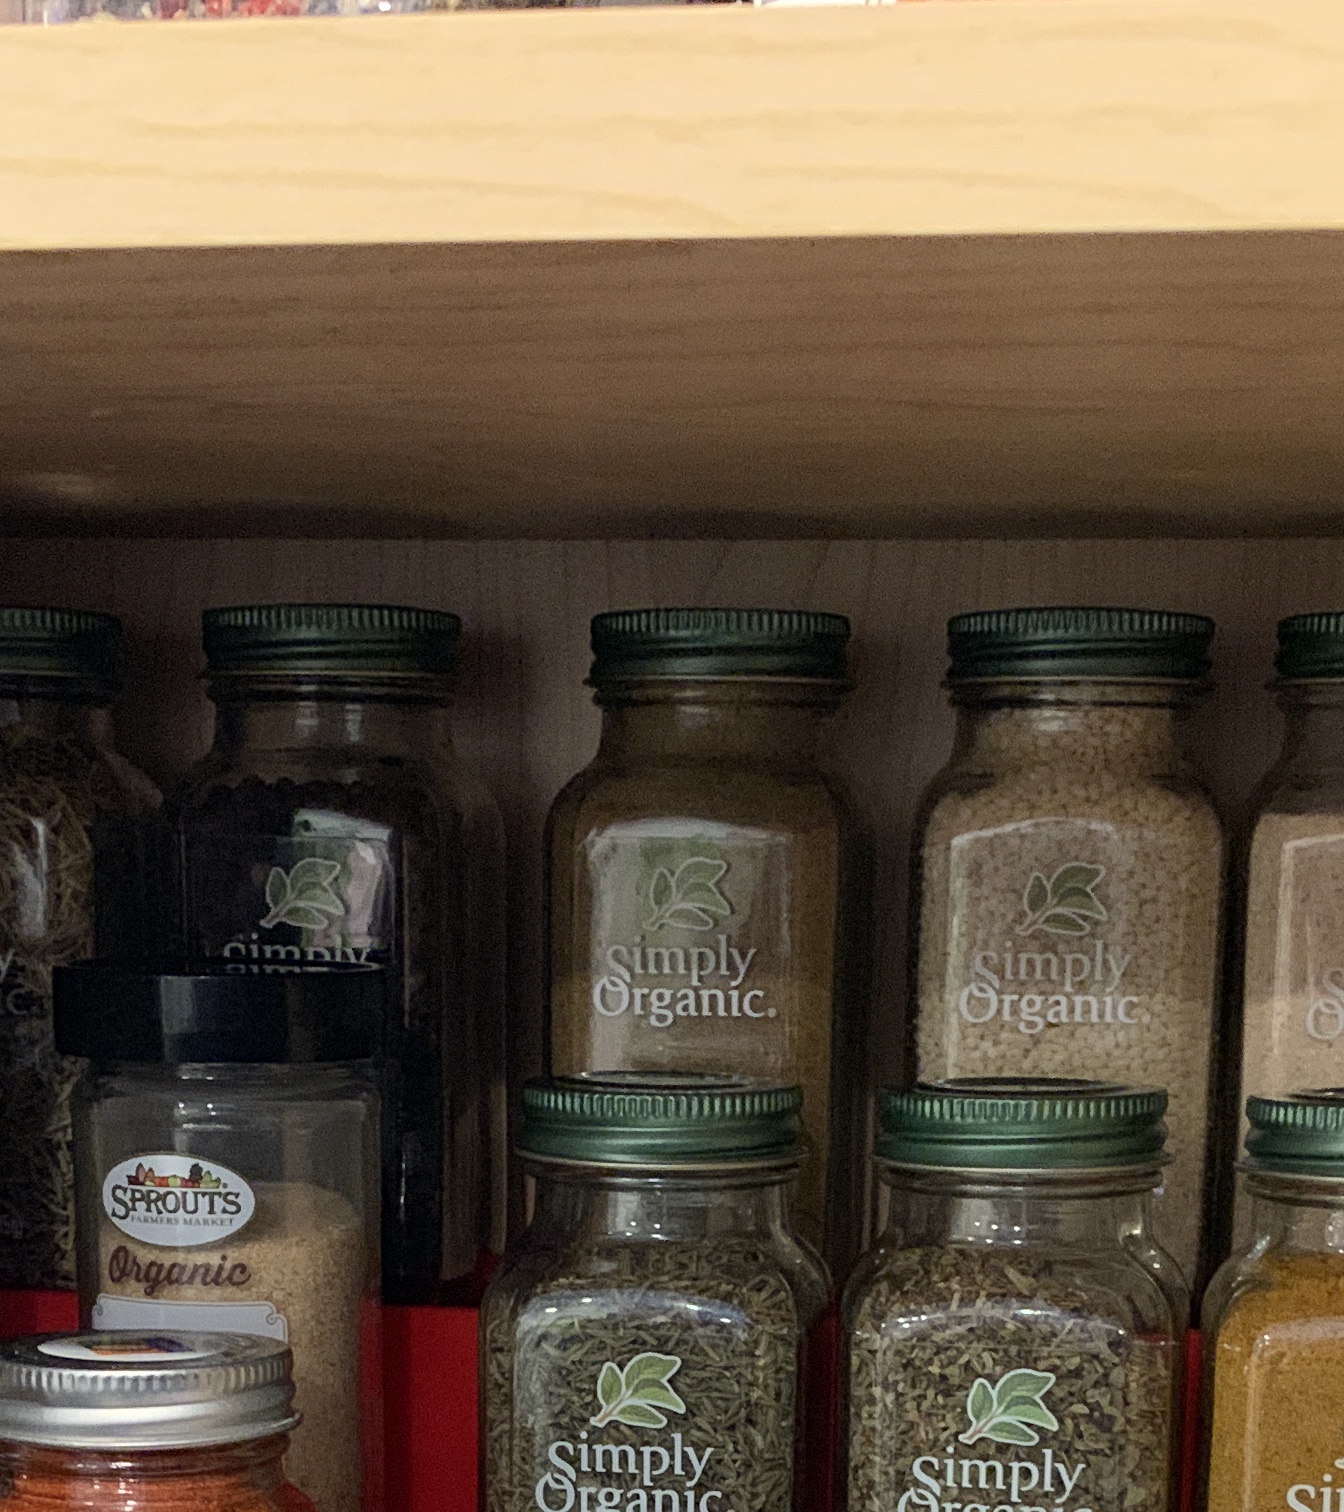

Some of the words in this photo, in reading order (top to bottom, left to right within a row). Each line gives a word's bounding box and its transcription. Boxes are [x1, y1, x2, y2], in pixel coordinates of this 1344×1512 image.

[605, 933, 756, 986] Simply
[974, 940, 1131, 992] Simply
[593, 976, 765, 1027] Organic
[959, 982, 1139, 1034] Organic
[111, 1184, 242, 1220] SPROUTS
[131, 1214, 179, 1225] FARMERS
[183, 1217, 235, 1226] MARKET
[109, 1245, 251, 1295] Organic
[548, 1431, 714, 1487] Simply
[912, 1446, 1086, 1503] Simply
